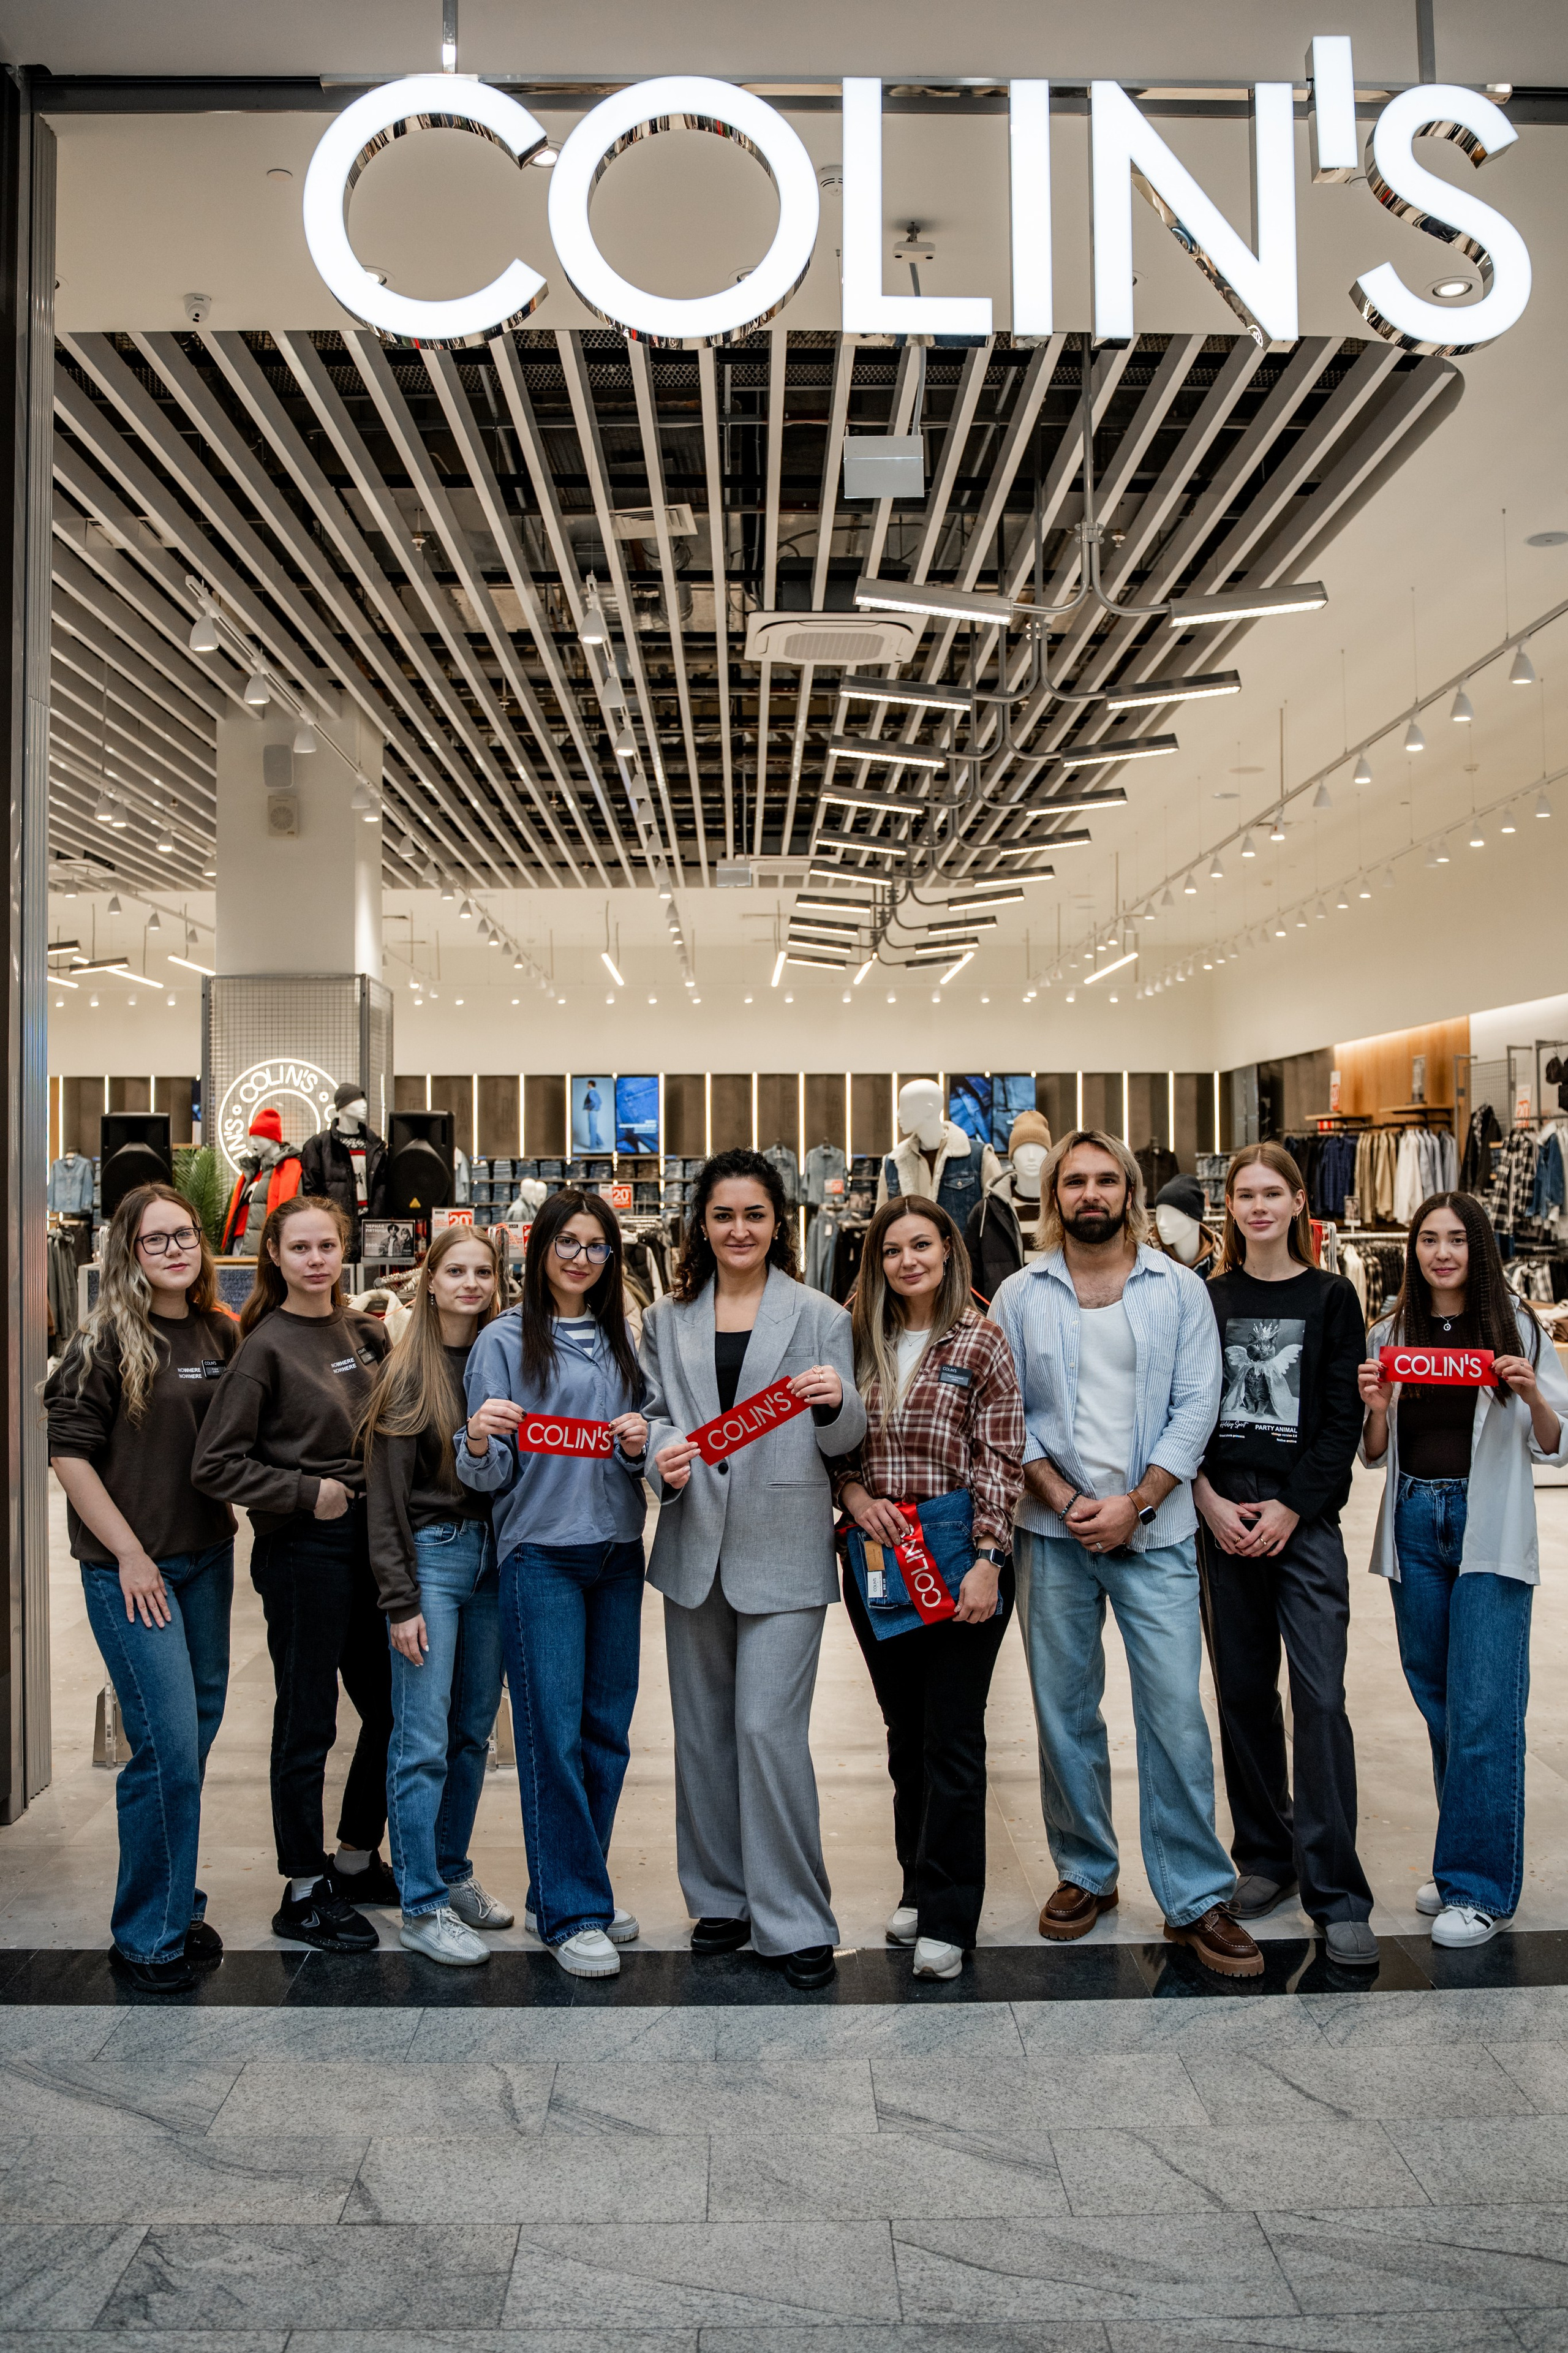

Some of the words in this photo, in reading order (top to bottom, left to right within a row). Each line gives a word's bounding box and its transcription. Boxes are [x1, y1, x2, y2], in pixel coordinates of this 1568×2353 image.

[303, 36, 1532, 357] COLIN'S
[239, 1065, 318, 1103] COLIN'S
[224, 1119, 253, 1160] IN'S
[331, 1358, 355, 1367] NOWHERE
[333, 1363, 356, 1373] NOWHERE
[1394, 1354, 1482, 1378] COLIN'S
[527, 1422, 611, 1451] COLIN'S
[707, 1394, 792, 1450] COLIN'S
[899, 1524, 941, 1607] COLINS
